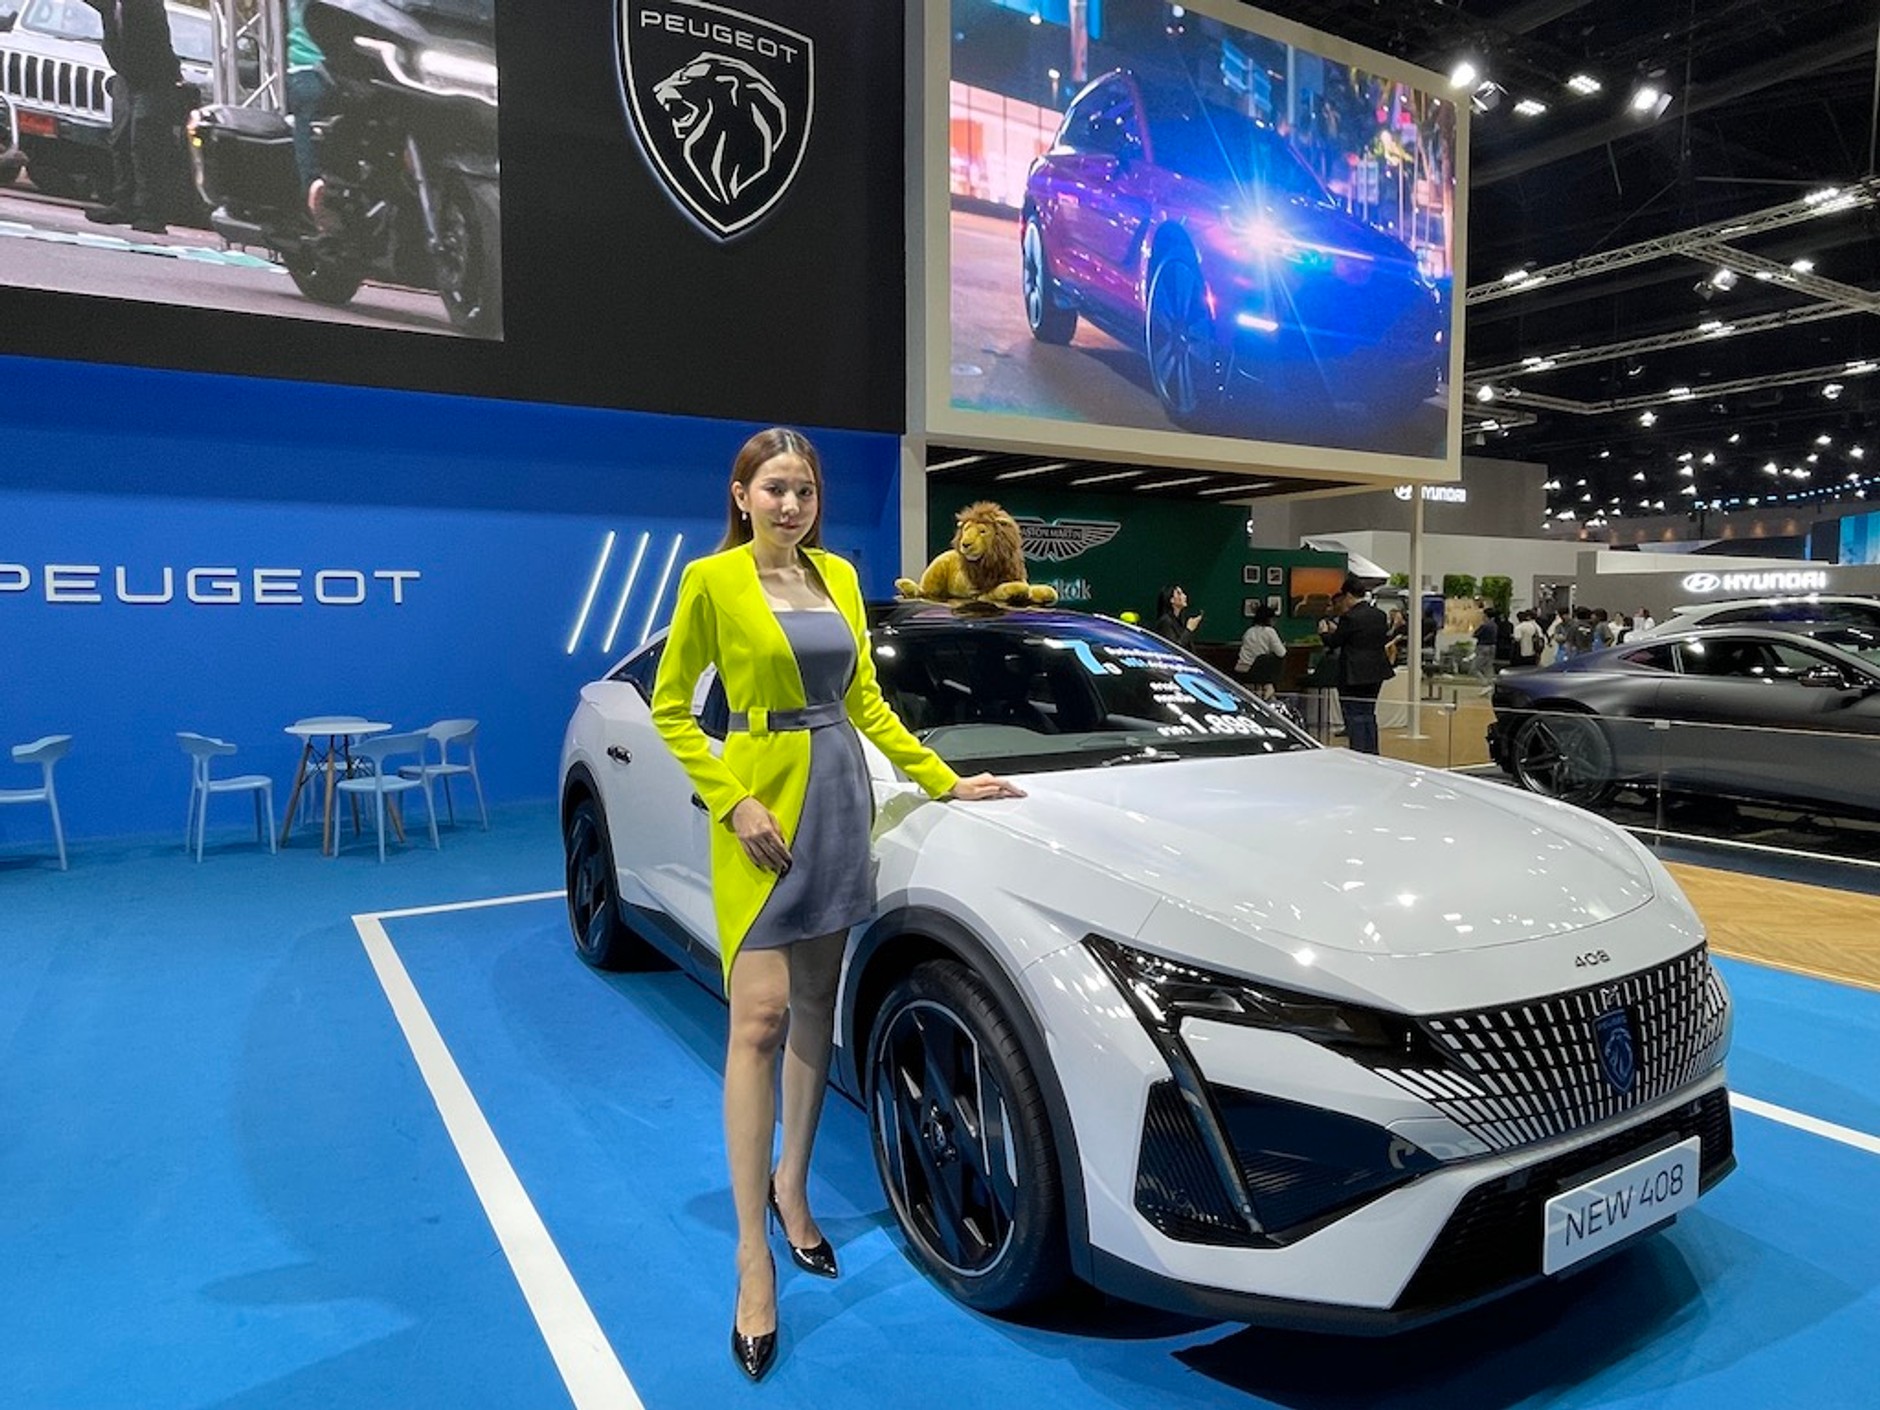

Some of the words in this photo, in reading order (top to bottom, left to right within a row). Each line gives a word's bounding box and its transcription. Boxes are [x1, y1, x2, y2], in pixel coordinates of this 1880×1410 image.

[640, 10, 798, 64] PEUGEOT
[1723, 571, 1827, 591] HYUNDAI
[1574, 949, 1611, 968] 408
[1565, 1184, 1634, 1247] NEW
[1639, 1163, 1684, 1207] 408
